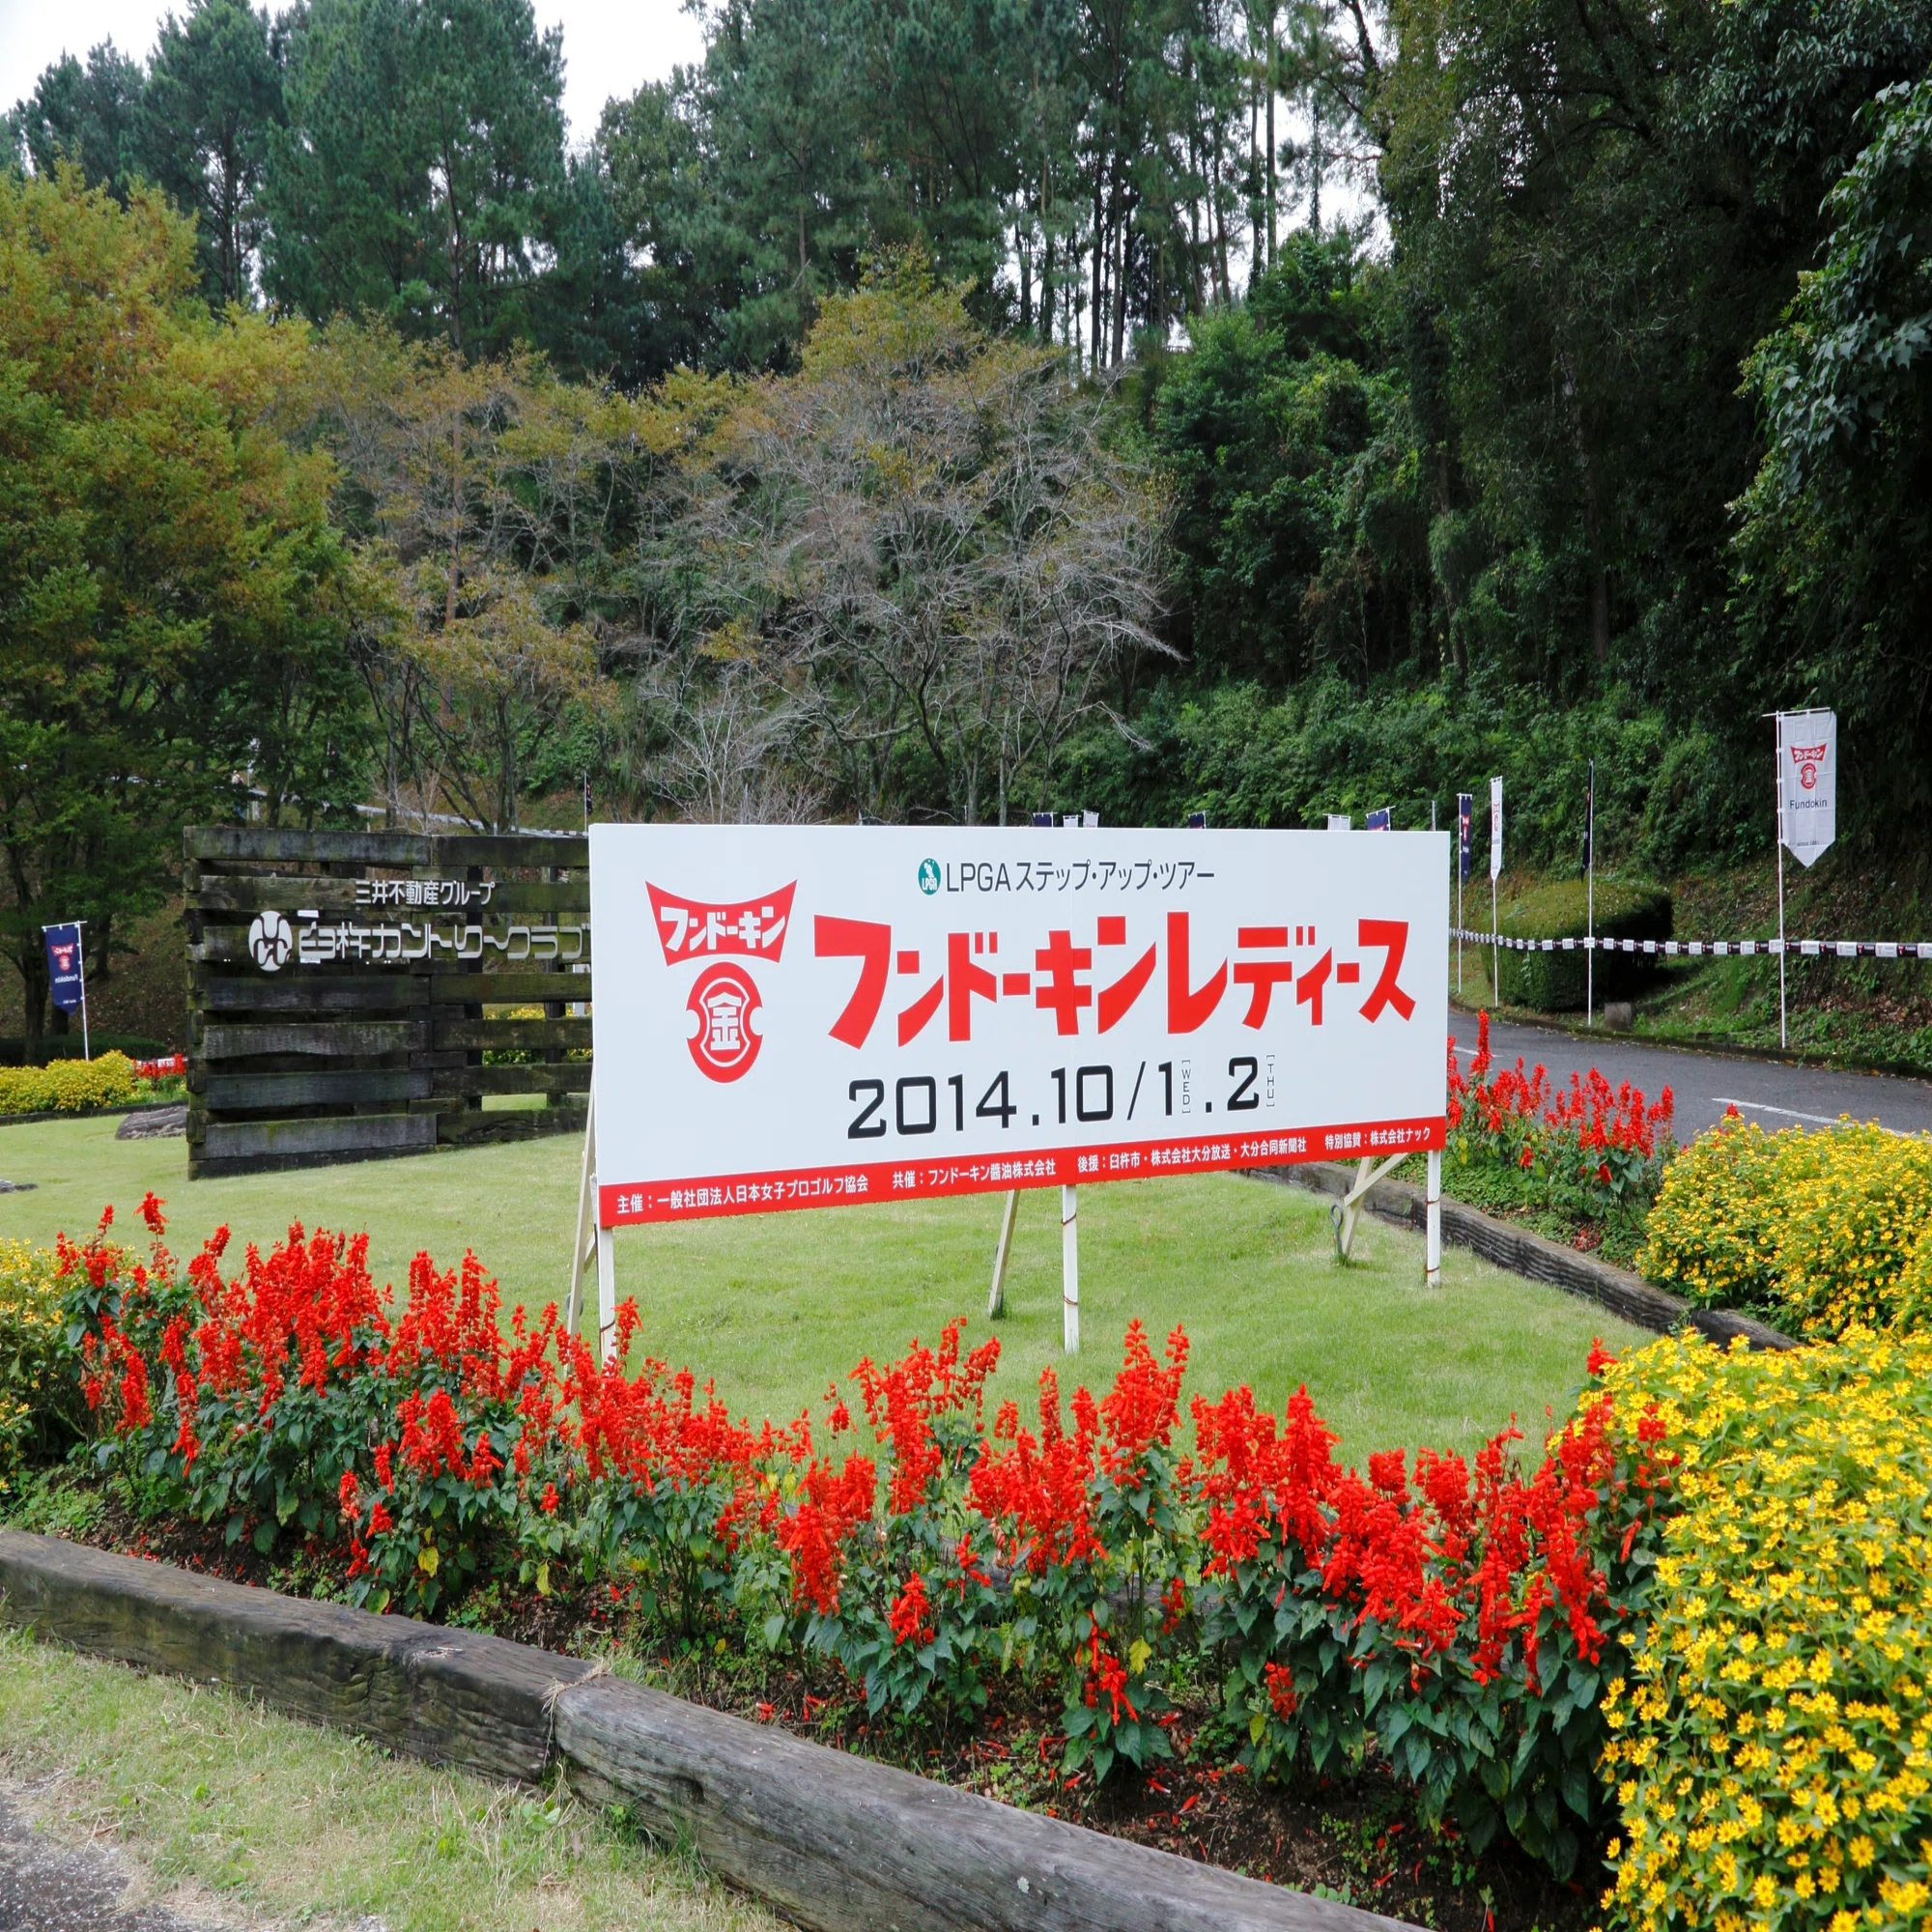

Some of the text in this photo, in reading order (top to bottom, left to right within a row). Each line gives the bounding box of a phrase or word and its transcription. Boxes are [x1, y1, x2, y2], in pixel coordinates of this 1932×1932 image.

[1789, 798, 1828, 810] Fundokin
[355, 880, 496, 905] 三井不動産グループ
[298, 921, 591, 959] 臼杵カントリークラブ
[660, 905, 786, 952] フンドーキン
[813, 911, 1416, 1050] フンドーキンレディース
[706, 991, 743, 1051] 金
[1324, 1126, 1431, 1151] 特別協賛：株式会社ナック
